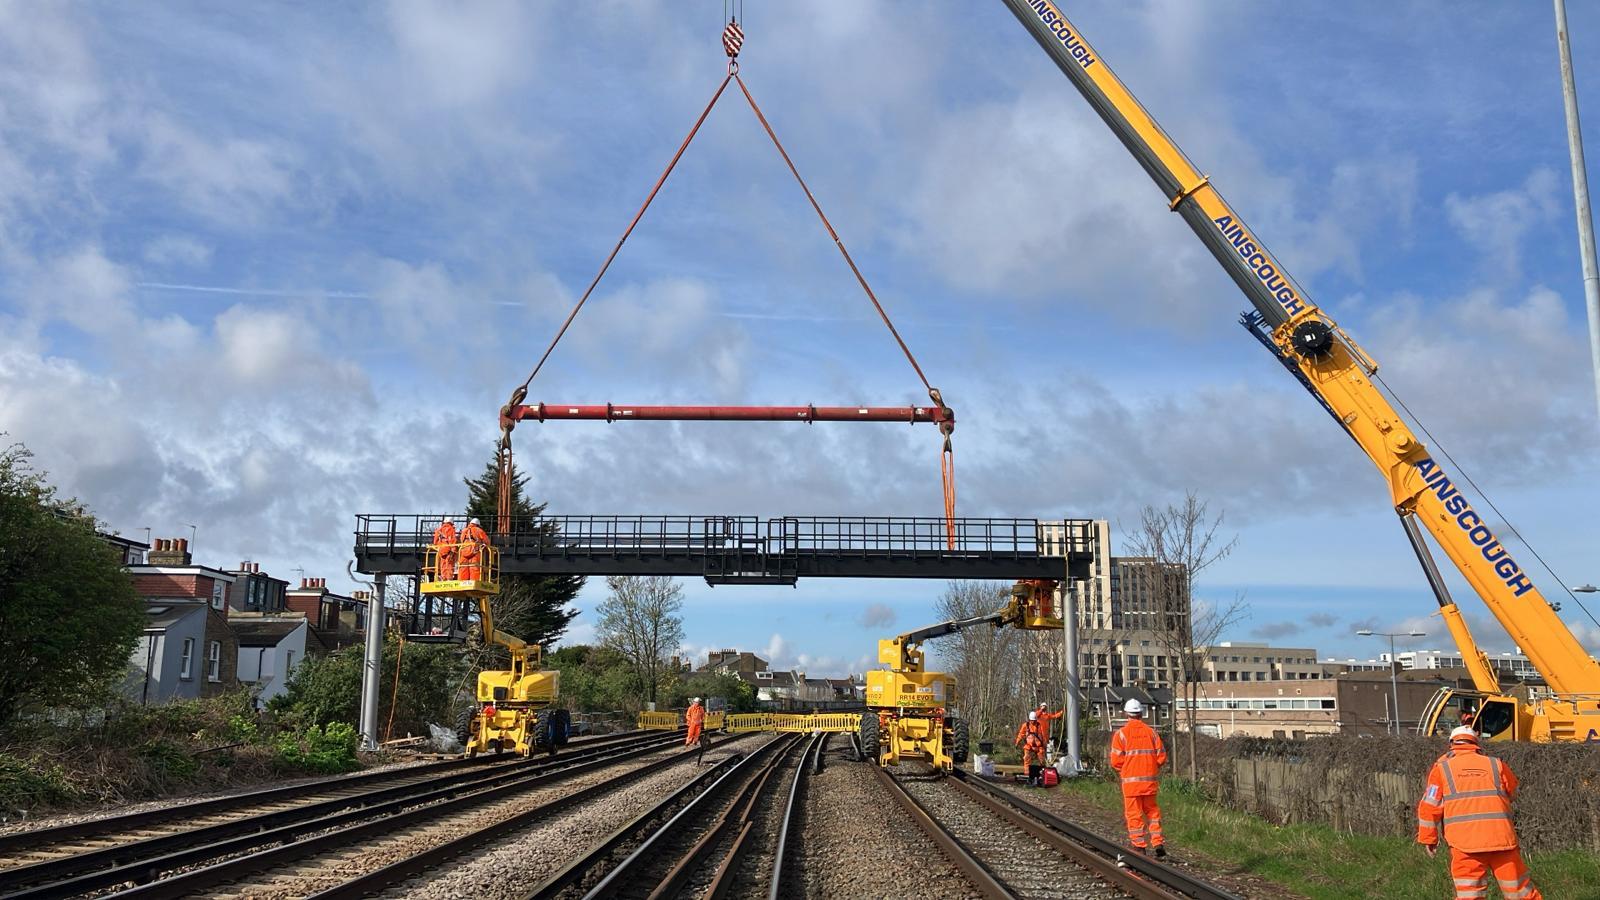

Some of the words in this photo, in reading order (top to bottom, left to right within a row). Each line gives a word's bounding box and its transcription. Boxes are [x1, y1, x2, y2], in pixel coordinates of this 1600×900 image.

[1025, 0, 1096, 69] INSCOUGH
[1214, 215, 1306, 317] AINSCOUGH
[1416, 457, 1534, 598] AINSCOUGH
